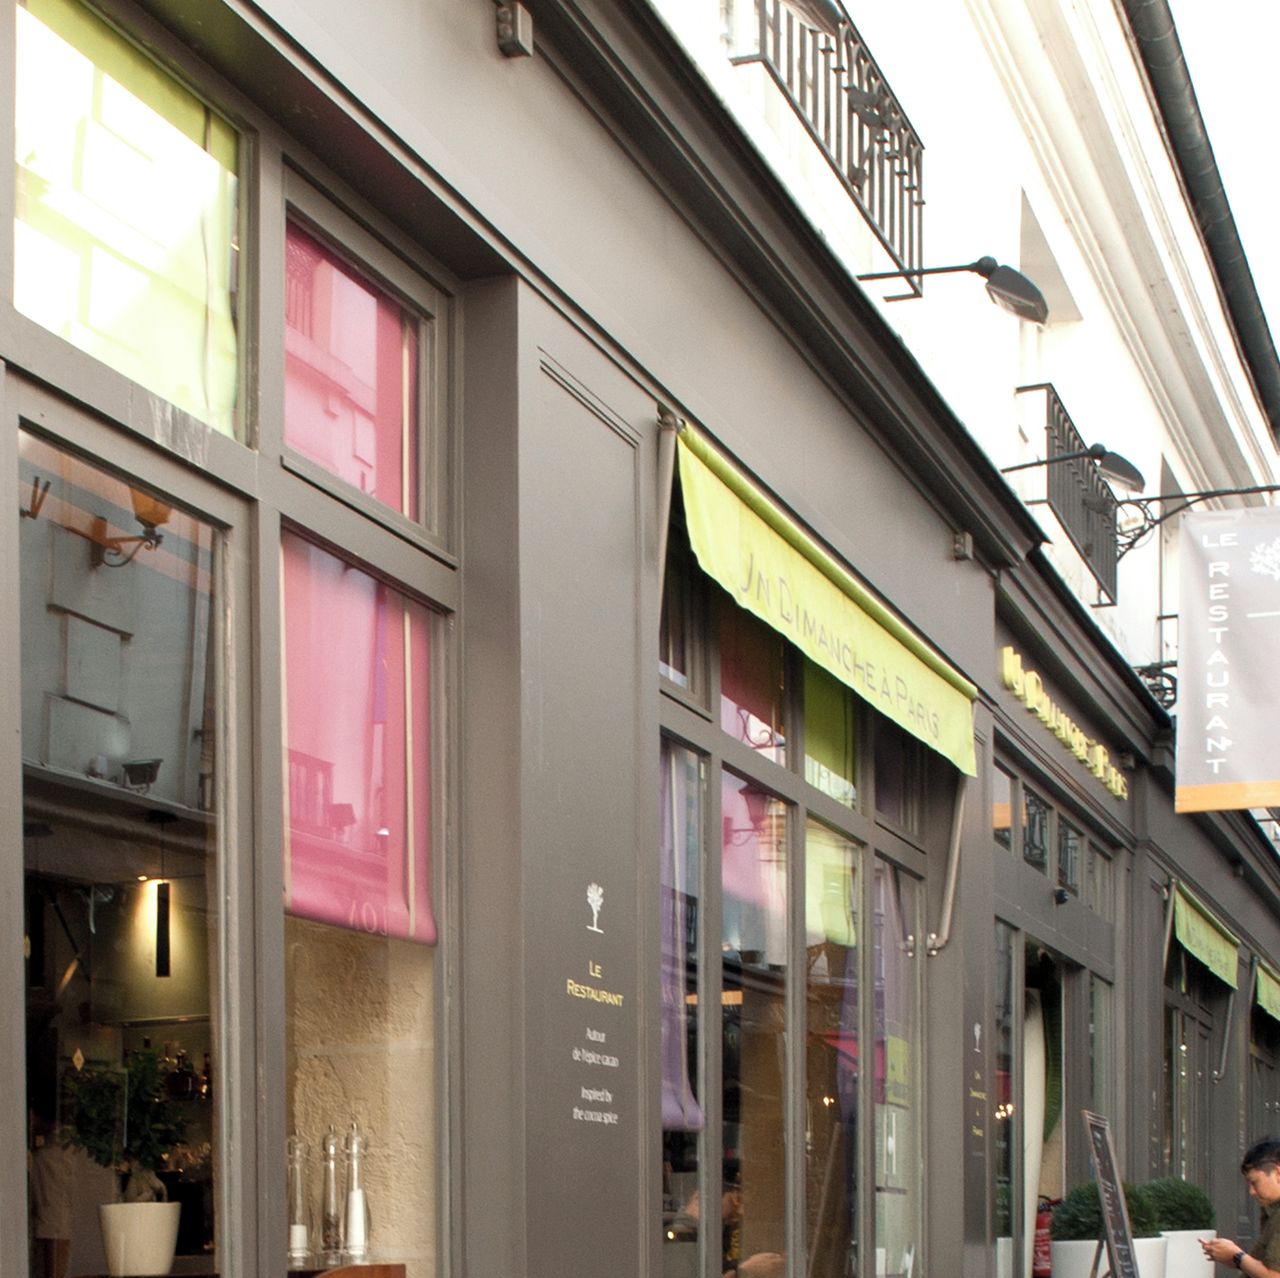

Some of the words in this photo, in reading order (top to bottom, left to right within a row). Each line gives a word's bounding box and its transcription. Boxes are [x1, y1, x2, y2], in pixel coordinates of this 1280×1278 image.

[1202, 532, 1238, 548] LE
[1205, 561, 1230, 774] RESTAURANT
[588, 960, 603, 978] LE
[566, 978, 624, 1007] RESTAURANT
